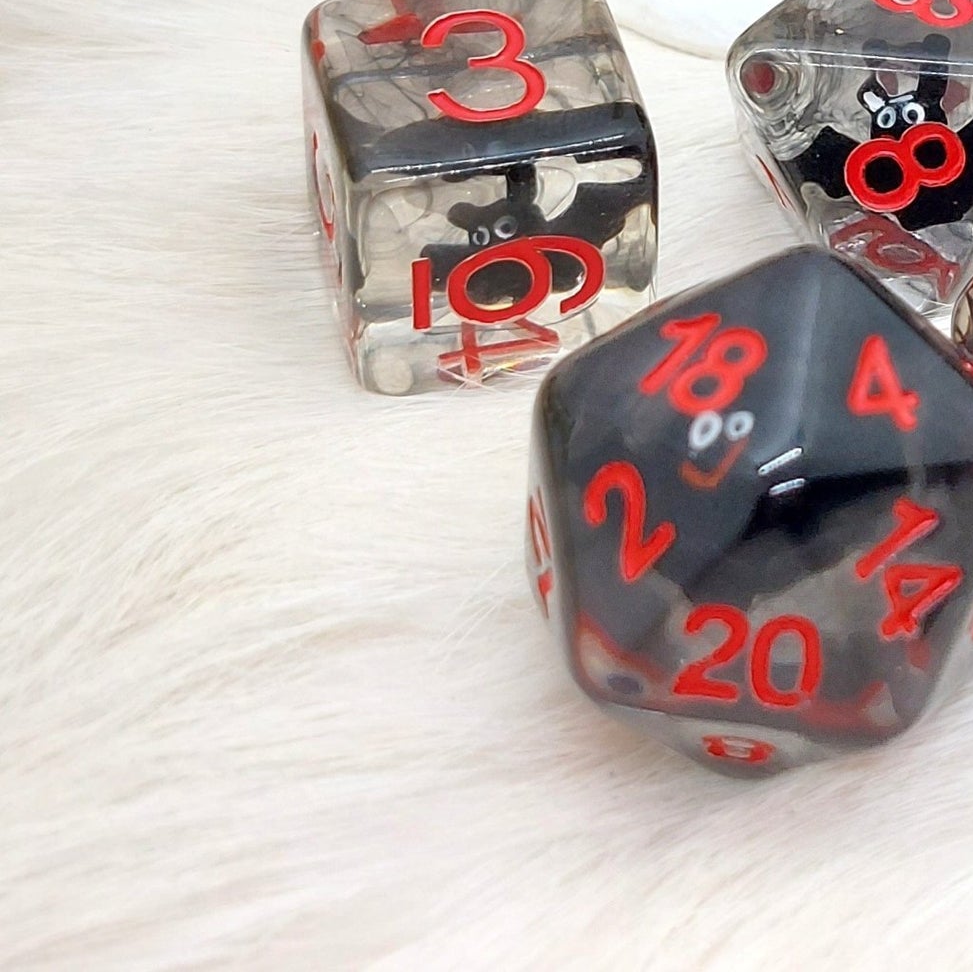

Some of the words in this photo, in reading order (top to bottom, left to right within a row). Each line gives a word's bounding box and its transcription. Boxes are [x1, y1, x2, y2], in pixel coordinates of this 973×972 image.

[420, 9, 547, 123] 3
[843, 120, 967, 213] 8
[640, 312, 768, 417] 18
[846, 333, 921, 432] 4
[582, 460, 677, 582] 2
[854, 495, 963, 643] 14
[671, 602, 824, 709] 20
